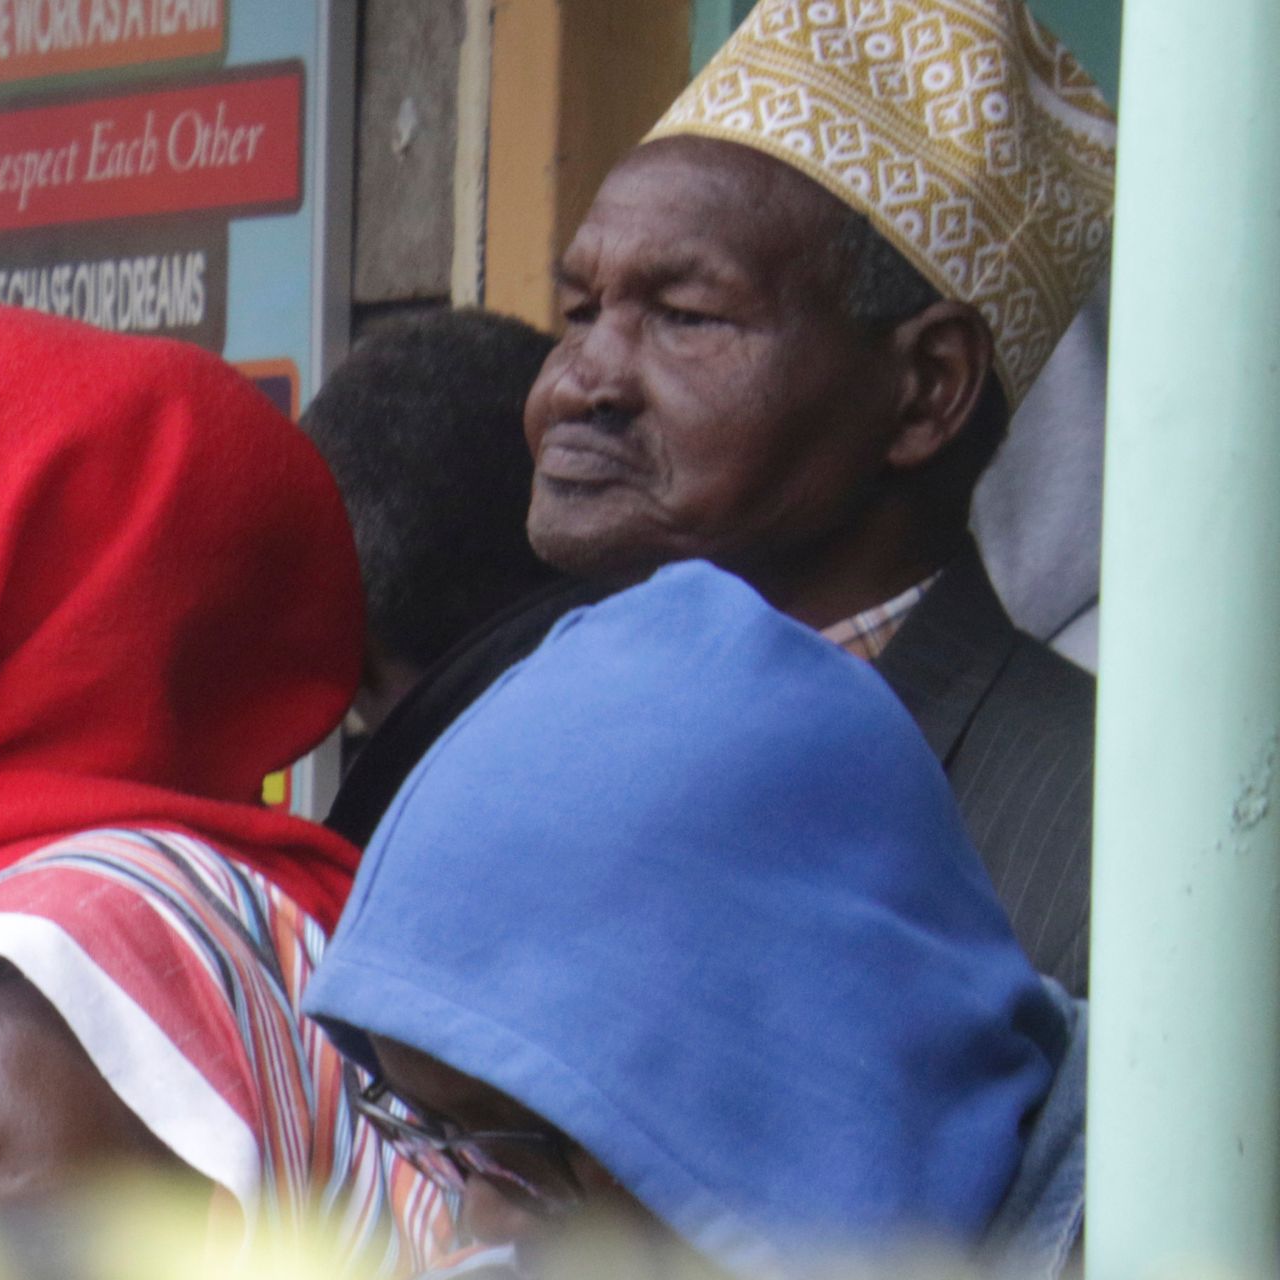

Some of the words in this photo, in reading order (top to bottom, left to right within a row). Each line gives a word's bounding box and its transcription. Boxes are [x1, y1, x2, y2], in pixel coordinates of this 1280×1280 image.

[83, 109, 159, 184] Each
[166, 100, 265, 173] Other
[72, 258, 116, 331] OUR
[117, 251, 206, 332] DREAMS
